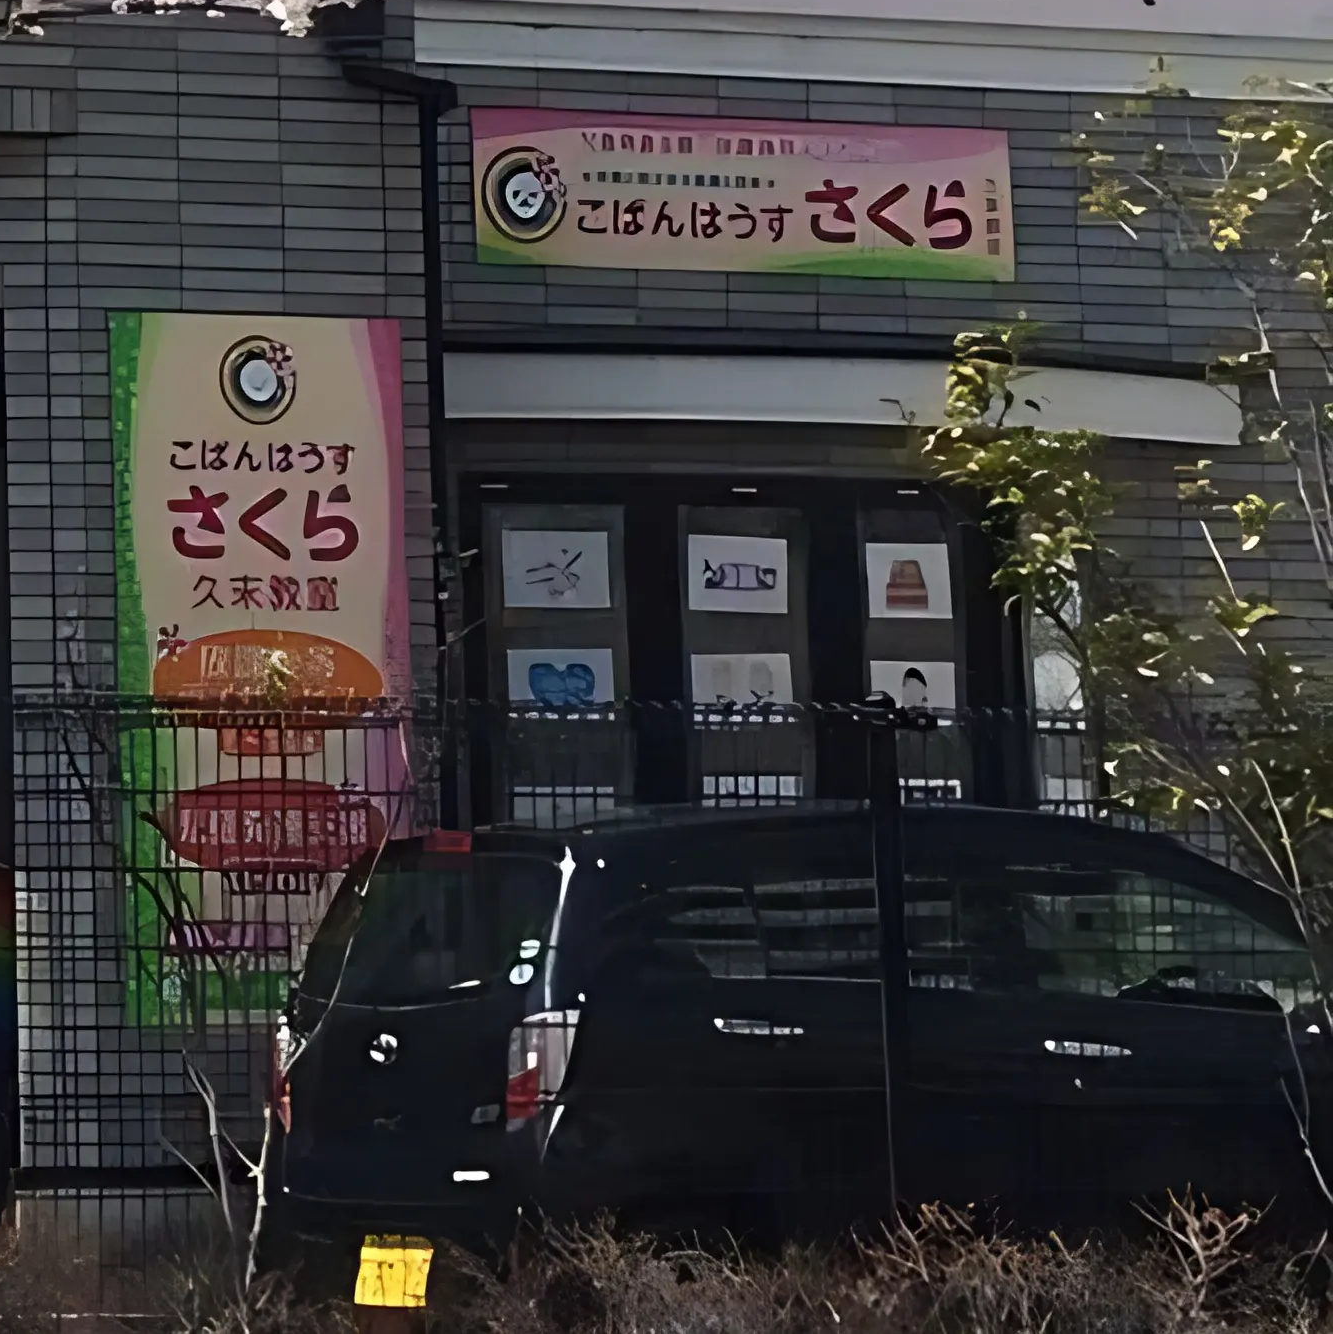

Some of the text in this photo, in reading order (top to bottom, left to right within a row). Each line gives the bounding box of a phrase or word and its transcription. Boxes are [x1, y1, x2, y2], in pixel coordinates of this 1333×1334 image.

[805, 179, 973, 250] さくら
[167, 484, 360, 562] さくら
